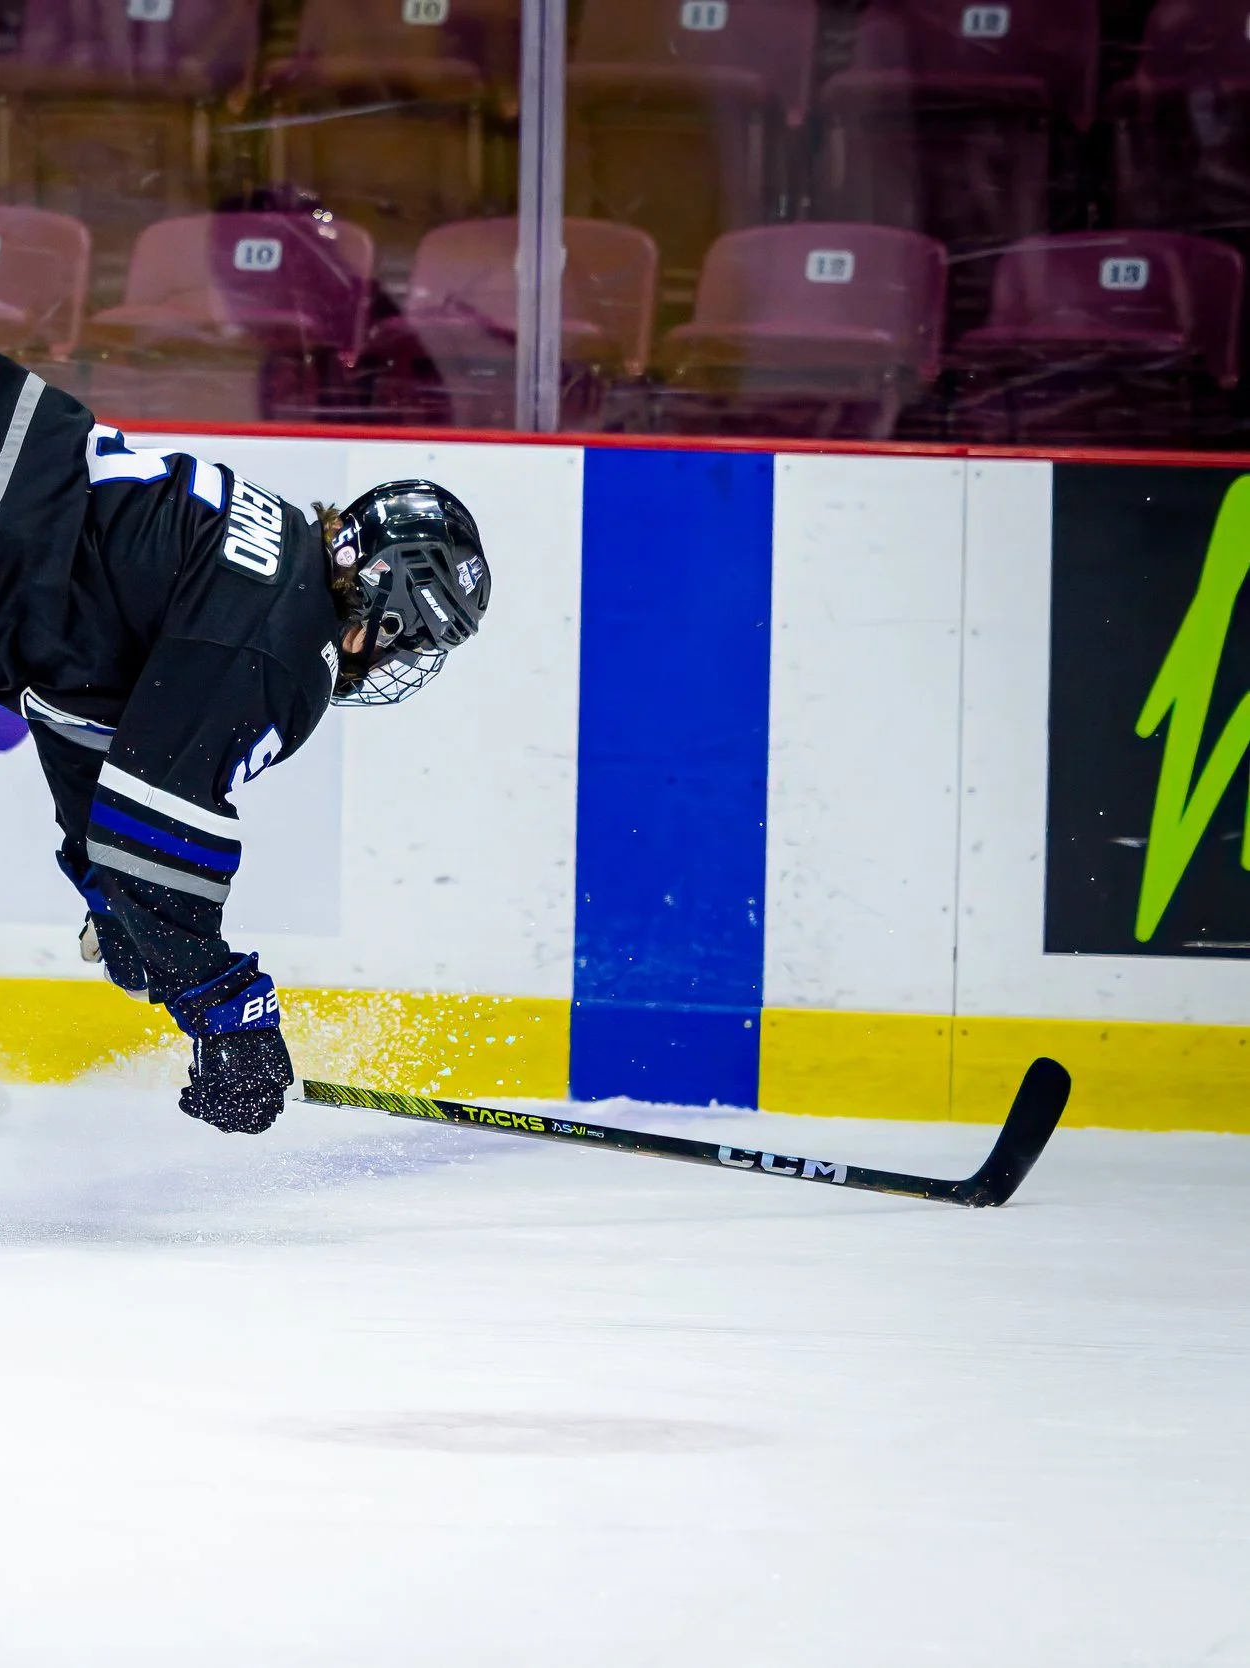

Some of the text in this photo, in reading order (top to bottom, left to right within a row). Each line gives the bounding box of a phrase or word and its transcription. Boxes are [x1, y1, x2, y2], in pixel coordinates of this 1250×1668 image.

[691, 4, 717, 26] 11
[245, 246, 274, 265] 10
[462, 1106, 545, 1132] TACKS
[718, 1145, 848, 1184] CCM
